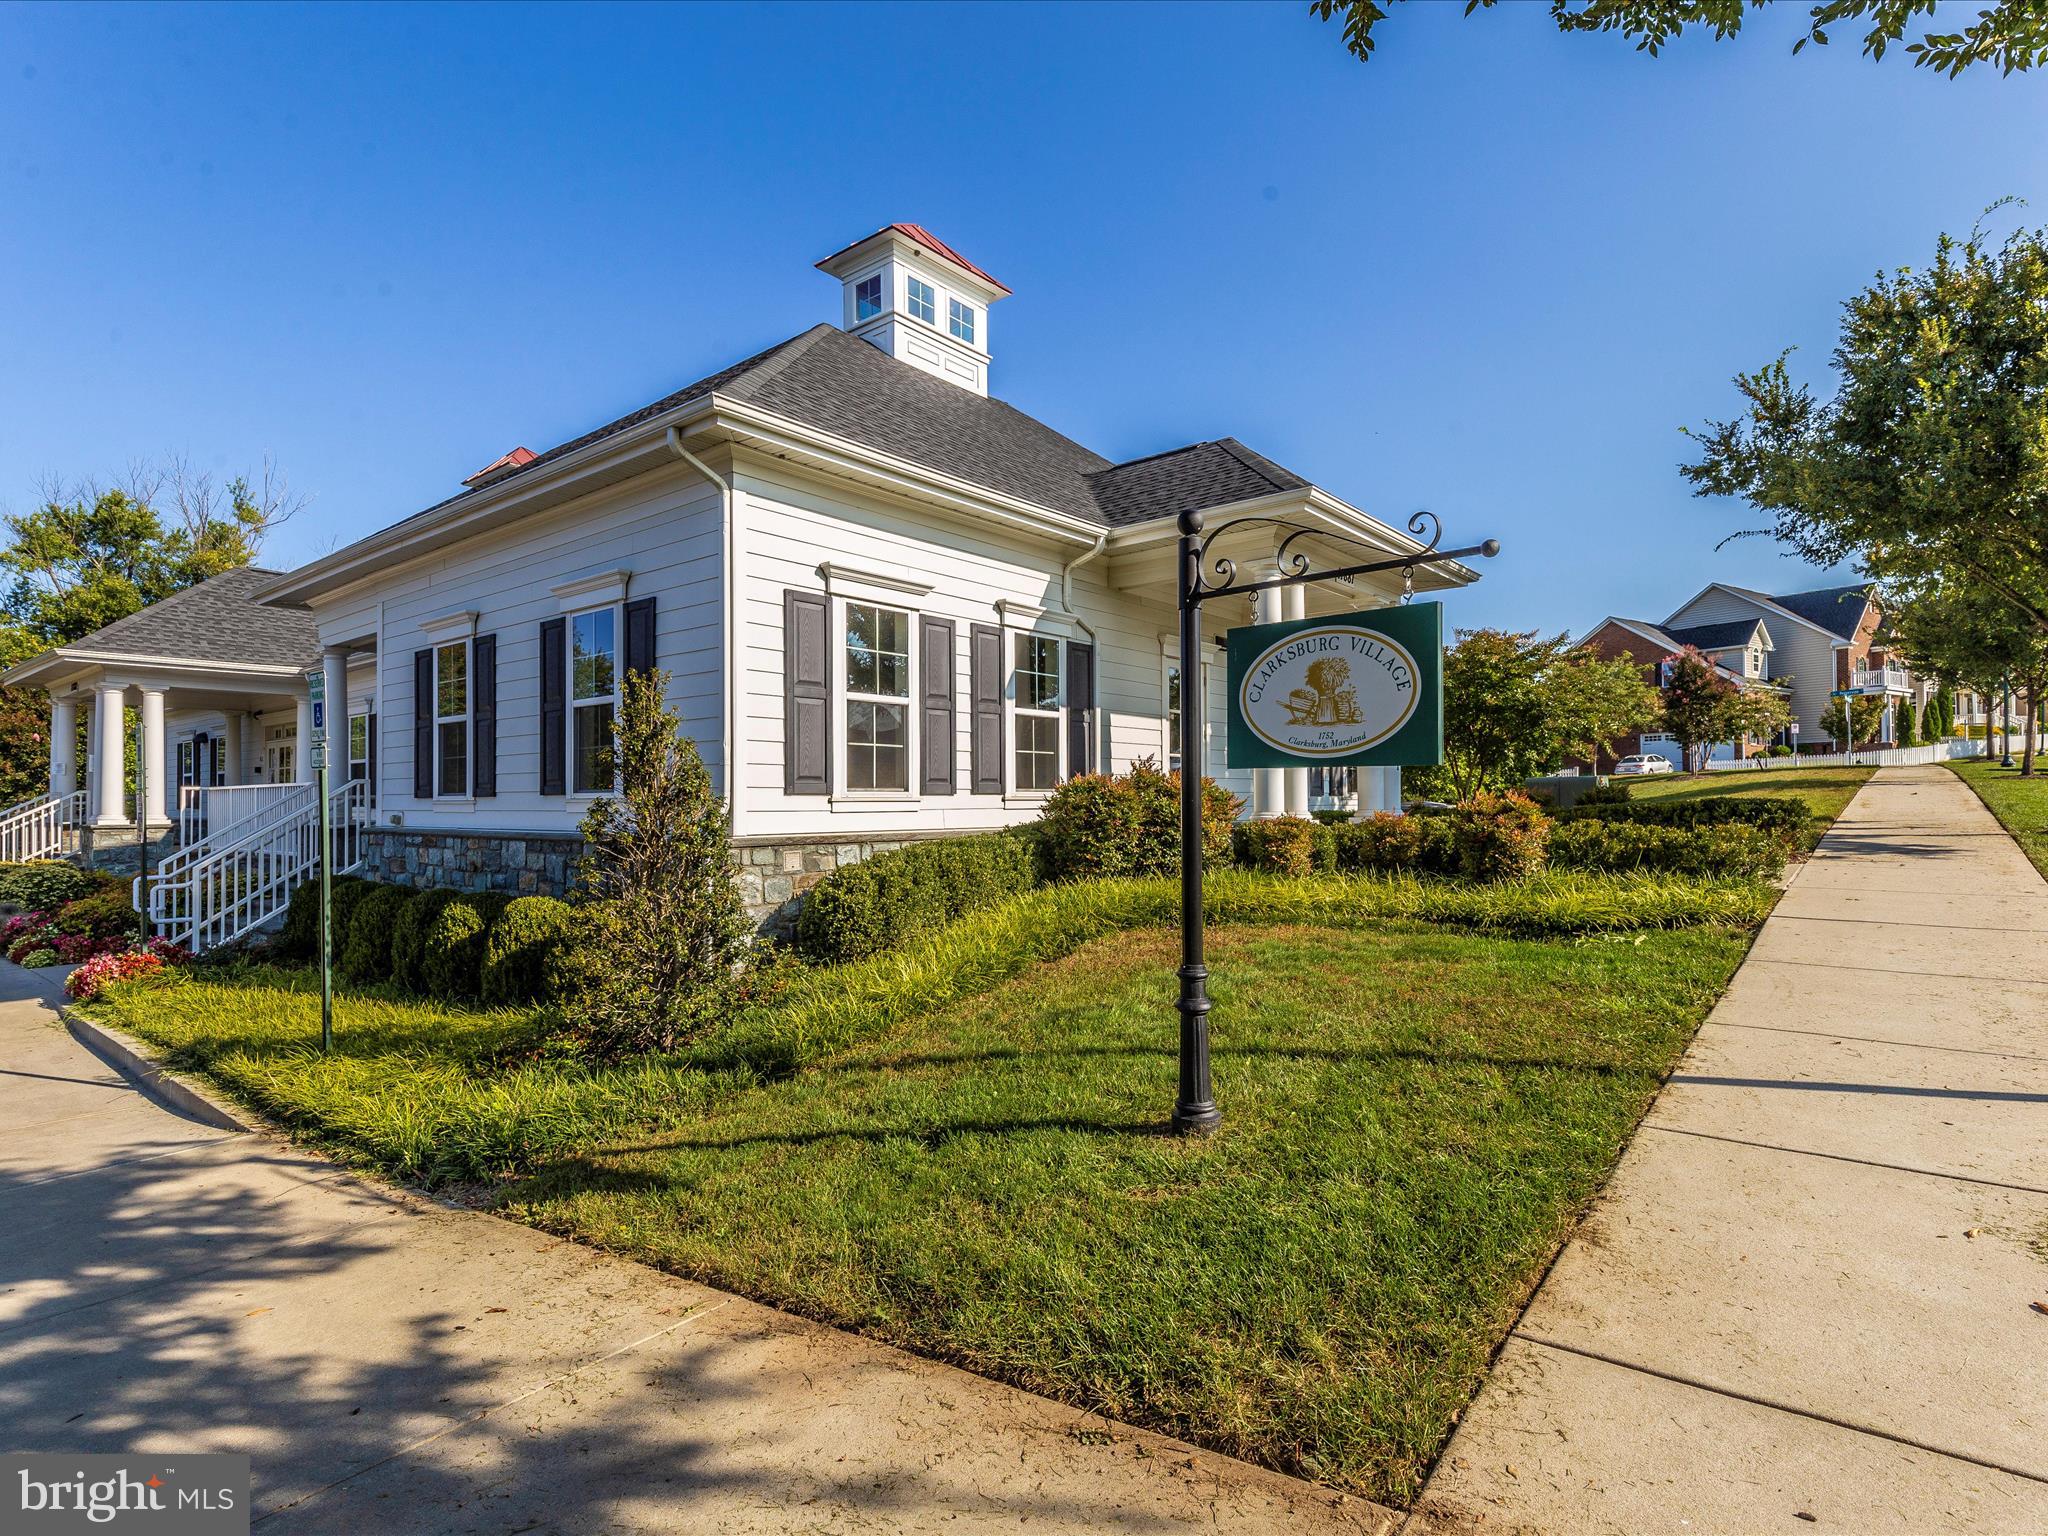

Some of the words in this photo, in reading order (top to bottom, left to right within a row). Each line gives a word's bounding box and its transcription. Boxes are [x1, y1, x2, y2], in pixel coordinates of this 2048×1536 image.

[1249, 636, 1340, 703] CLARKSBURG
[1350, 636, 1412, 692] VILLAGE
[1288, 736, 1329, 749] Clarksburg,
[1331, 731, 1367, 747] Maryland
[1318, 731, 1334, 740] 1752
